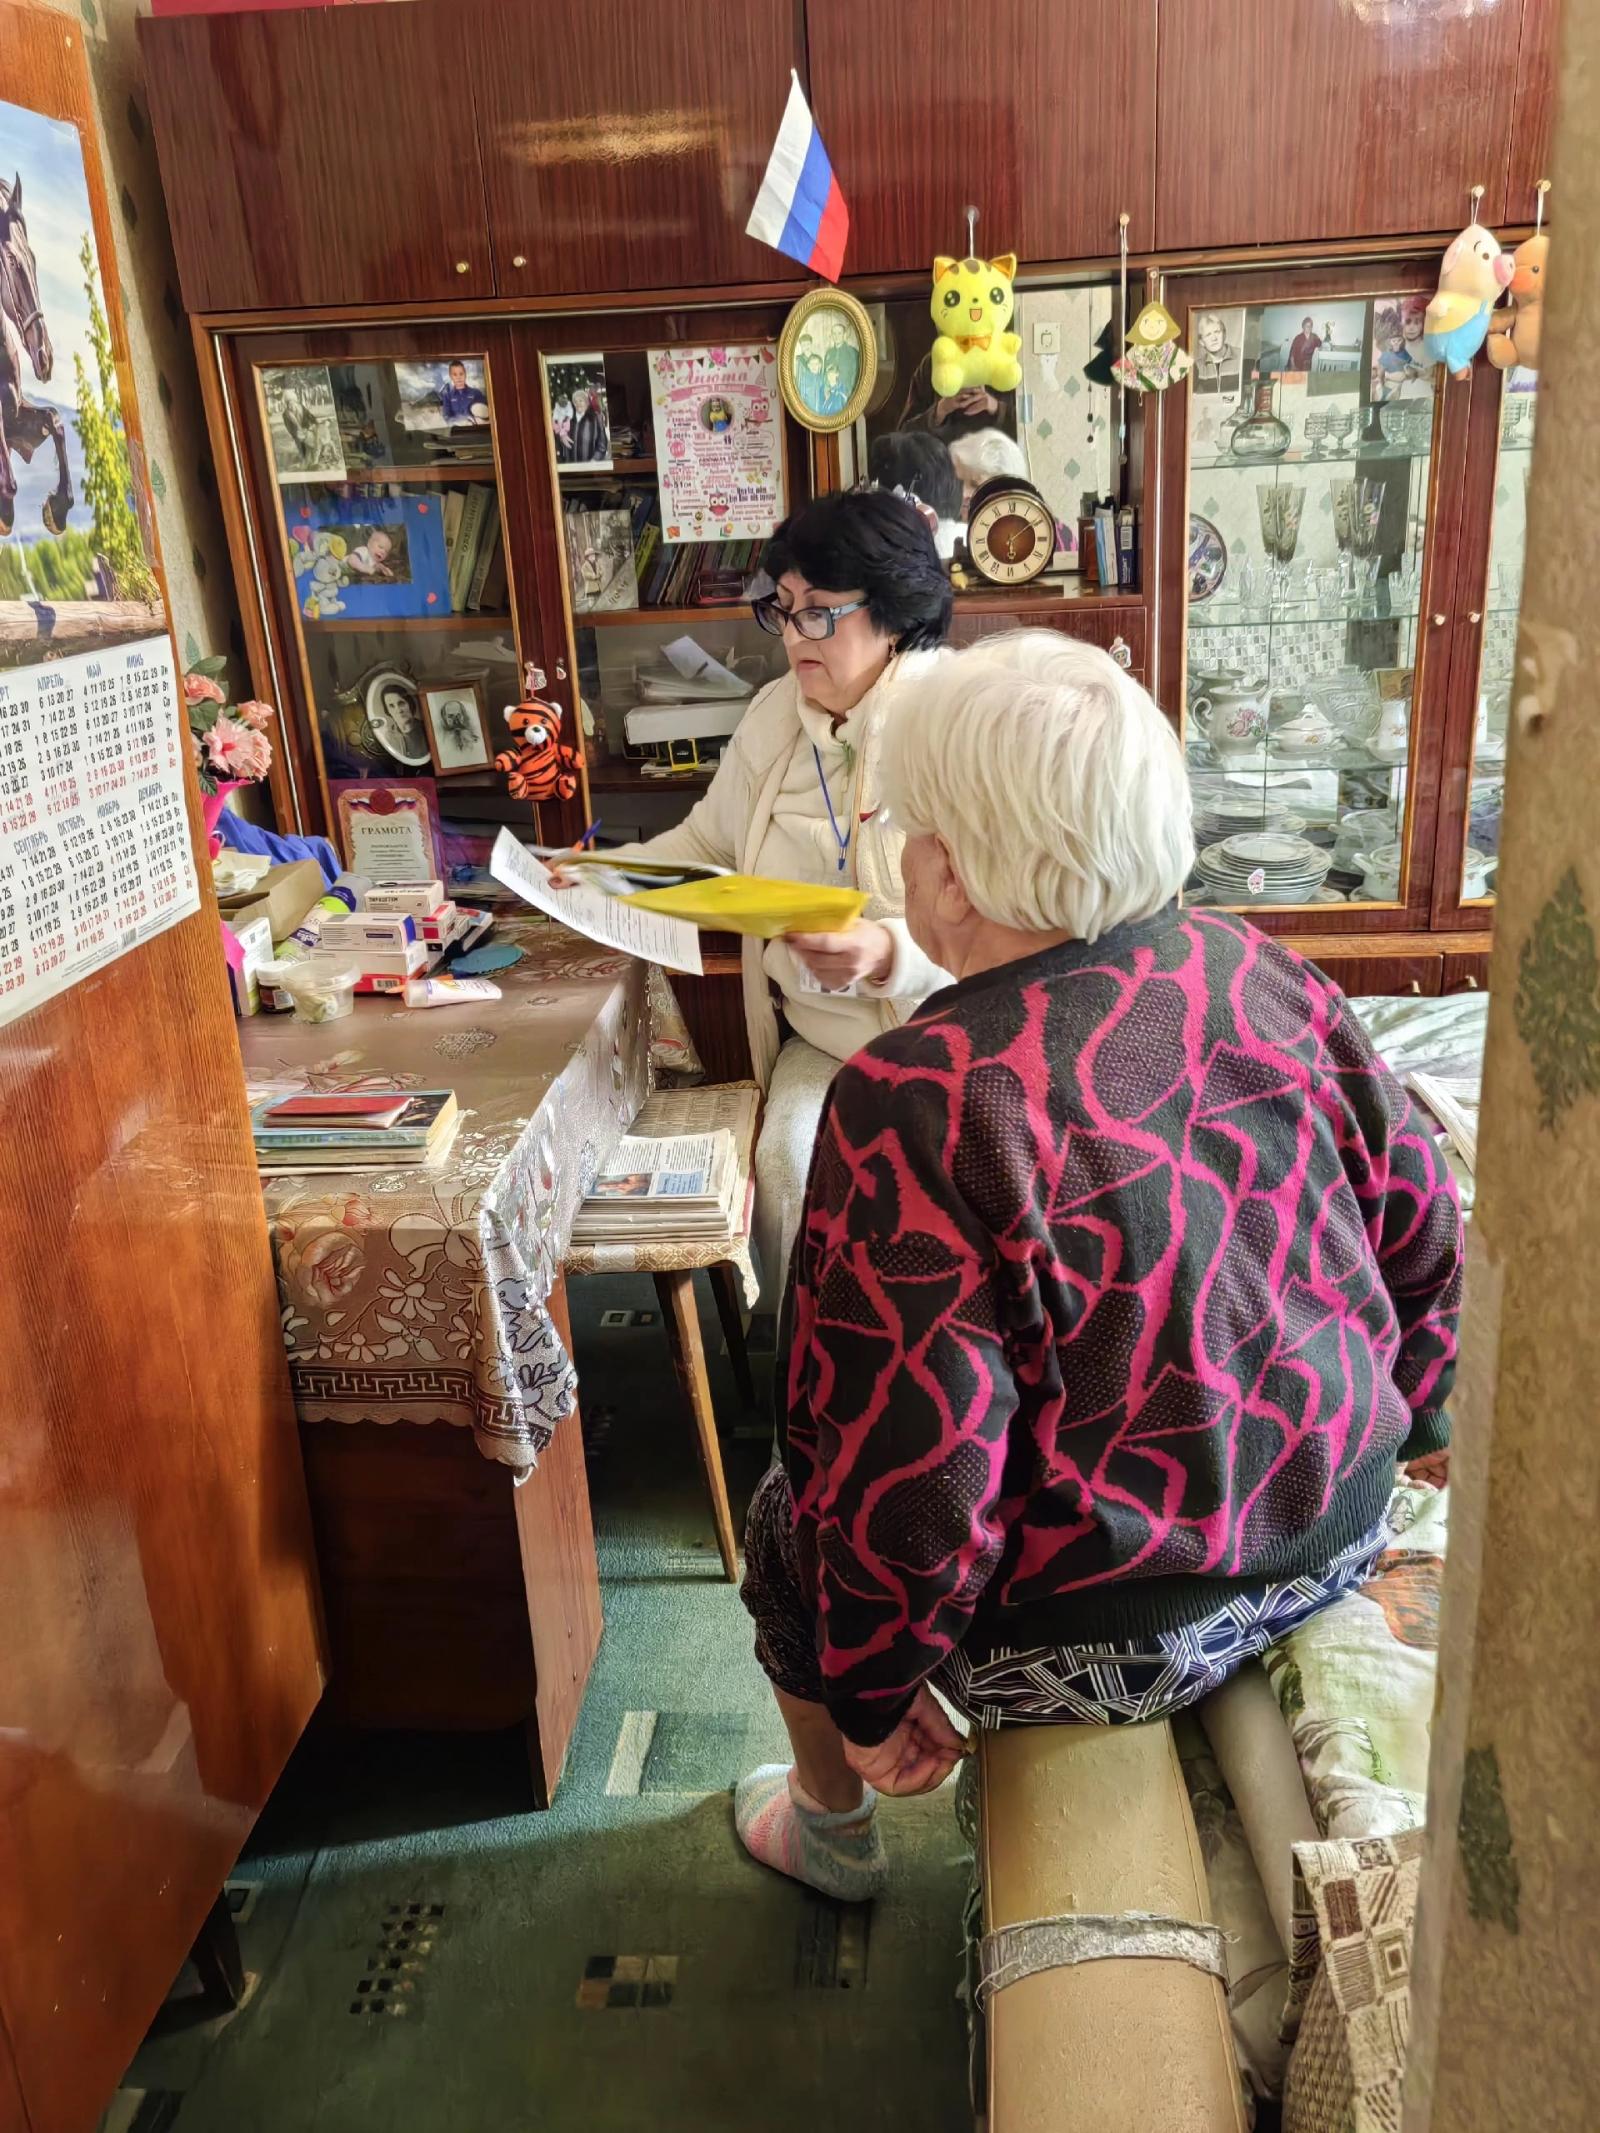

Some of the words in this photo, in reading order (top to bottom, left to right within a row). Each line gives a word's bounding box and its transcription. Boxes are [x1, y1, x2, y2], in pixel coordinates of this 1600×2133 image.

[86, 663, 101, 679] МАЙ
[37, 673, 64, 692] АПРЕЛЬ
[39, 696, 44, 709] 6
[47, 694, 55, 706] 13
[56, 691, 65, 704] 20
[66, 688, 74, 701] 27
[10, 704, 18, 717] 23
[20, 701, 29, 714] 30
[41, 714, 45, 725] 7
[49, 711, 57, 724] 14
[59, 709, 65, 721] 21
[1, 725, 9, 738] 17
[11, 722, 20, 735] 24
[22, 719, 31, 732] 31
[43, 732, 48, 743] 8
[51, 729, 59, 741] 15
[60, 726, 68, 738] 22
[4, 743, 12, 756] 18
[14, 740, 23, 753] 25
[38, 752, 43, 764] 2
[54, 746, 62, 758] 16
[62, 743, 70, 755] 23
[7, 761, 16, 774] 19
[18, 758, 27, 770] 26
[41, 769, 46, 781] 3
[47, 766, 55, 779] 10
[56, 763, 63, 776] 17
[65, 760, 73, 772] 24
[1, 782, 9, 795] 13
[10, 779, 20, 793] 20
[21, 776, 29, 789] 27
[6, 800, 14, 813] 14
[57, 813, 85, 836] ОКТЯБРЬ
[361, 825, 413, 835] ГРАМОТА
[13, 830, 49, 856] СЕНТЯБРЬ
[22, 858, 28, 870] 7
[30, 854, 39, 867] 14
[38, 850, 47, 863] 21
[47, 846, 56, 859] 28
[6, 864, 15, 878] 31
[28, 875, 35, 887] 8
[36, 871, 45, 884] 15
[44, 866, 54, 880] 22
[53, 862, 63, 876] 29
[2, 886, 12, 900] 25
[25, 896, 30, 908] 2
[41, 887, 48, 901] 16
[49, 883, 57, 897] 23
[7, 904, 15, 918] 26
[27, 913, 32, 925] 3
[33, 909, 41, 922] 10
[42, 905, 49, 918] 17
[51, 900, 59, 913] 24
[8, 921, 15, 935] 27
[35, 926, 43, 939] 11
[1, 944, 9, 958] 21
[4, 961, 13, 975] 22
